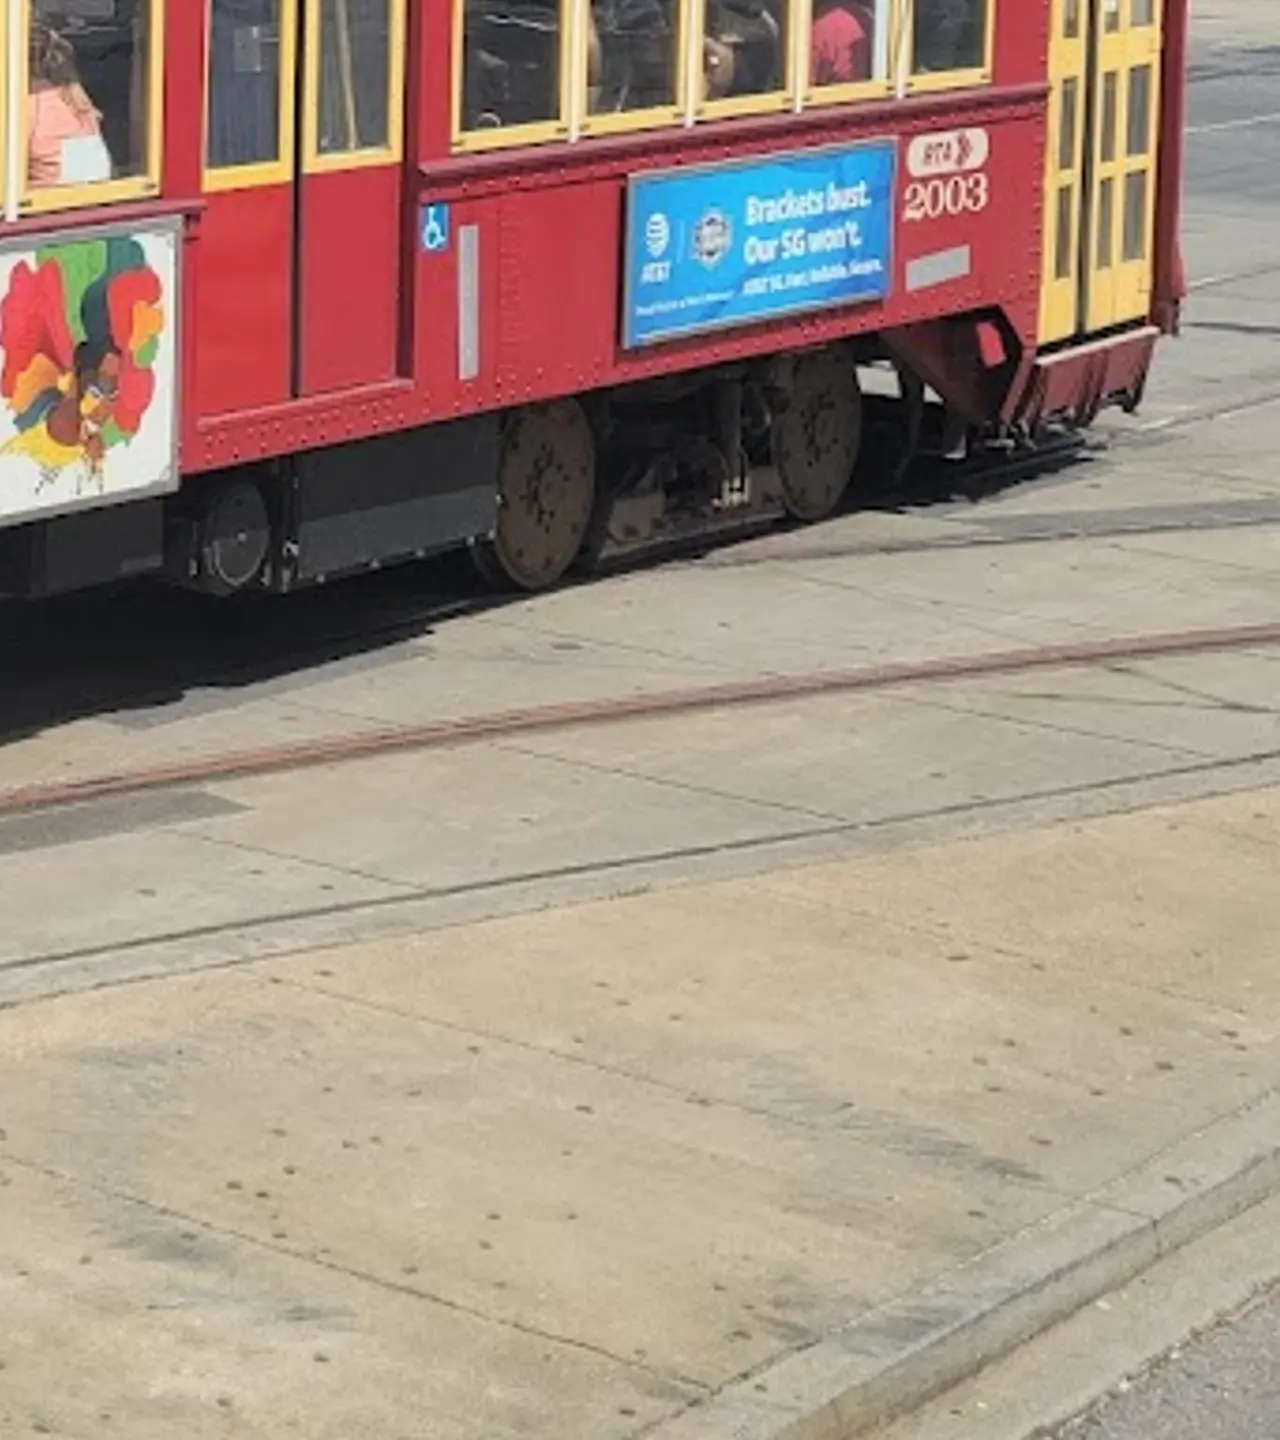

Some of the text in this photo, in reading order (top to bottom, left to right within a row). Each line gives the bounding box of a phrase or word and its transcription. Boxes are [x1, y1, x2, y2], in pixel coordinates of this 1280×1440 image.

[745, 188, 824, 226] Brackets
[902, 172, 989, 222] 2003
[744, 235, 779, 266] Our
[781, 228, 806, 260] 5G
